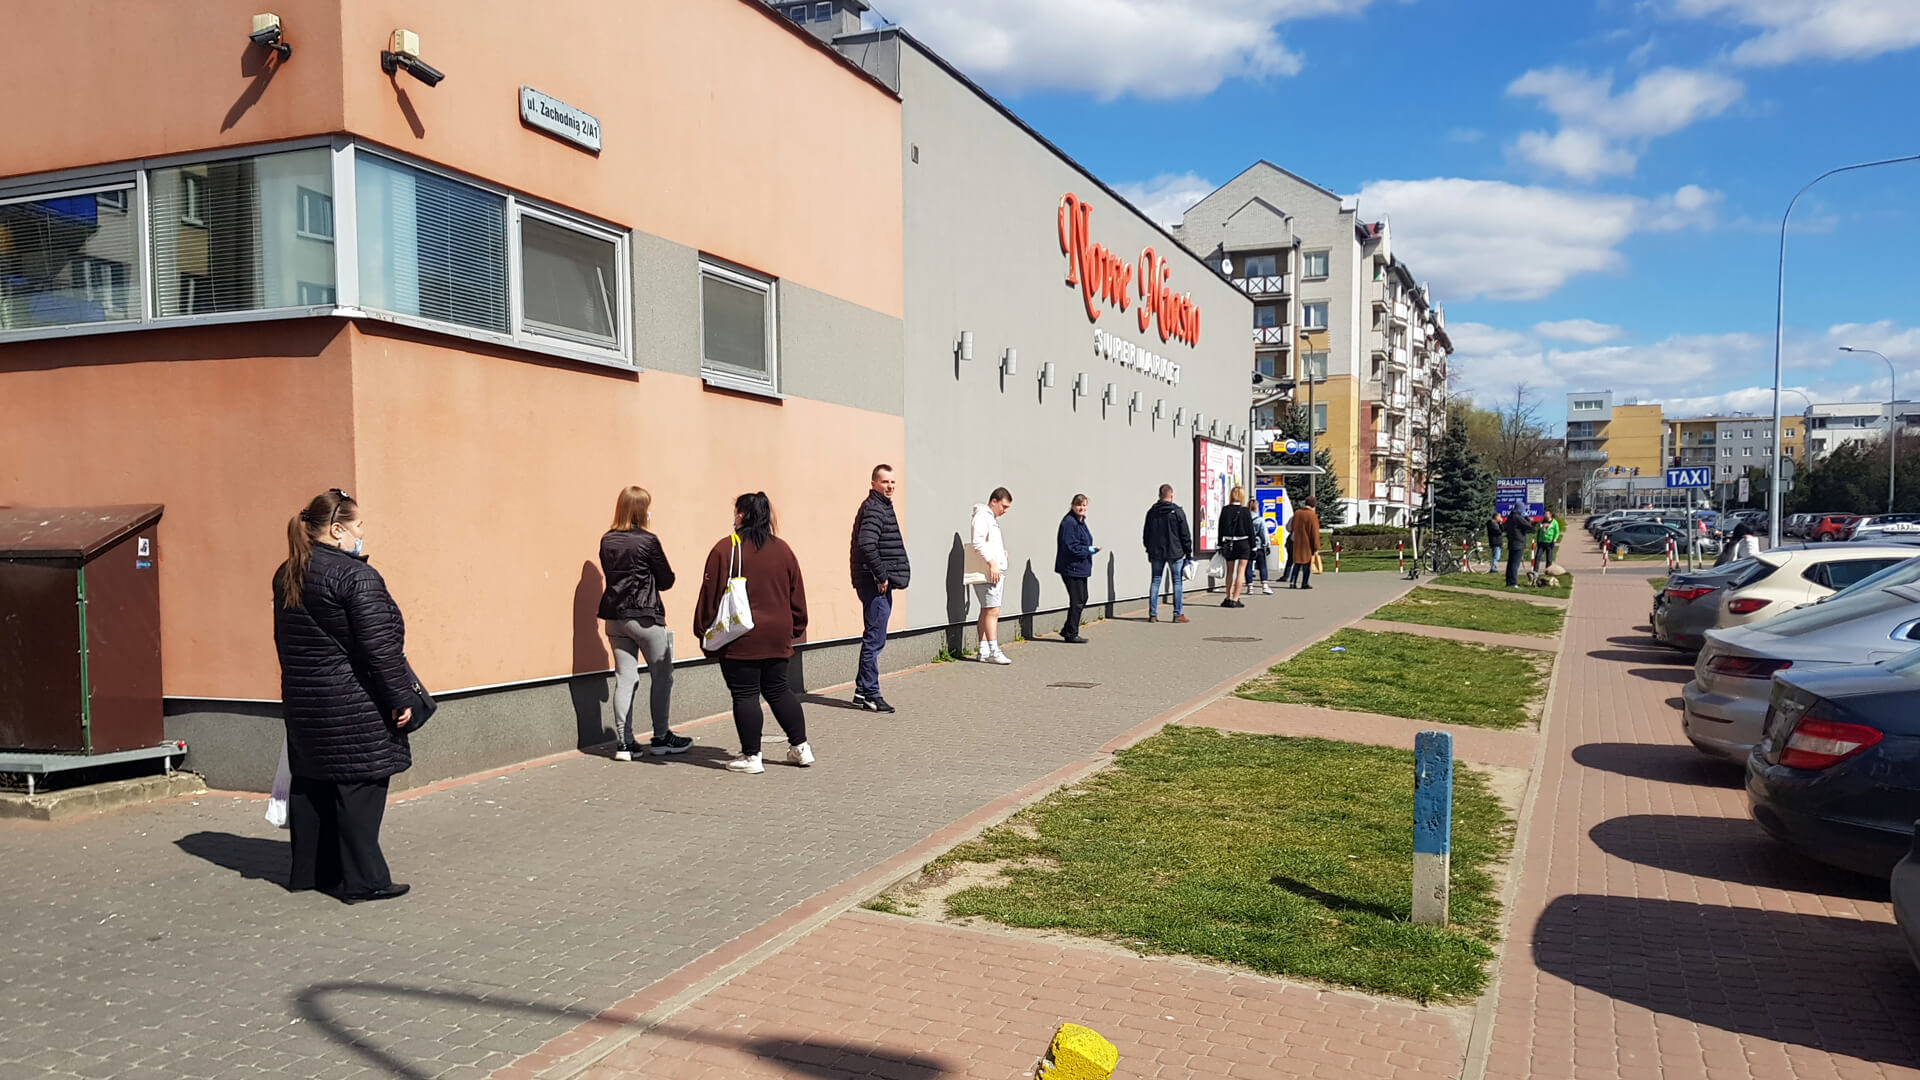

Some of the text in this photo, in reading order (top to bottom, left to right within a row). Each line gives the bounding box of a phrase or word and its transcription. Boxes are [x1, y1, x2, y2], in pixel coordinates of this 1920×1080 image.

[527, 97, 598, 139] ul. Zachodnią 2/A1
[1058, 192, 1200, 346] Nowe Miasto
[1094, 328, 1181, 384] SUPERMARKET
[1668, 469, 1708, 486] TAXI
